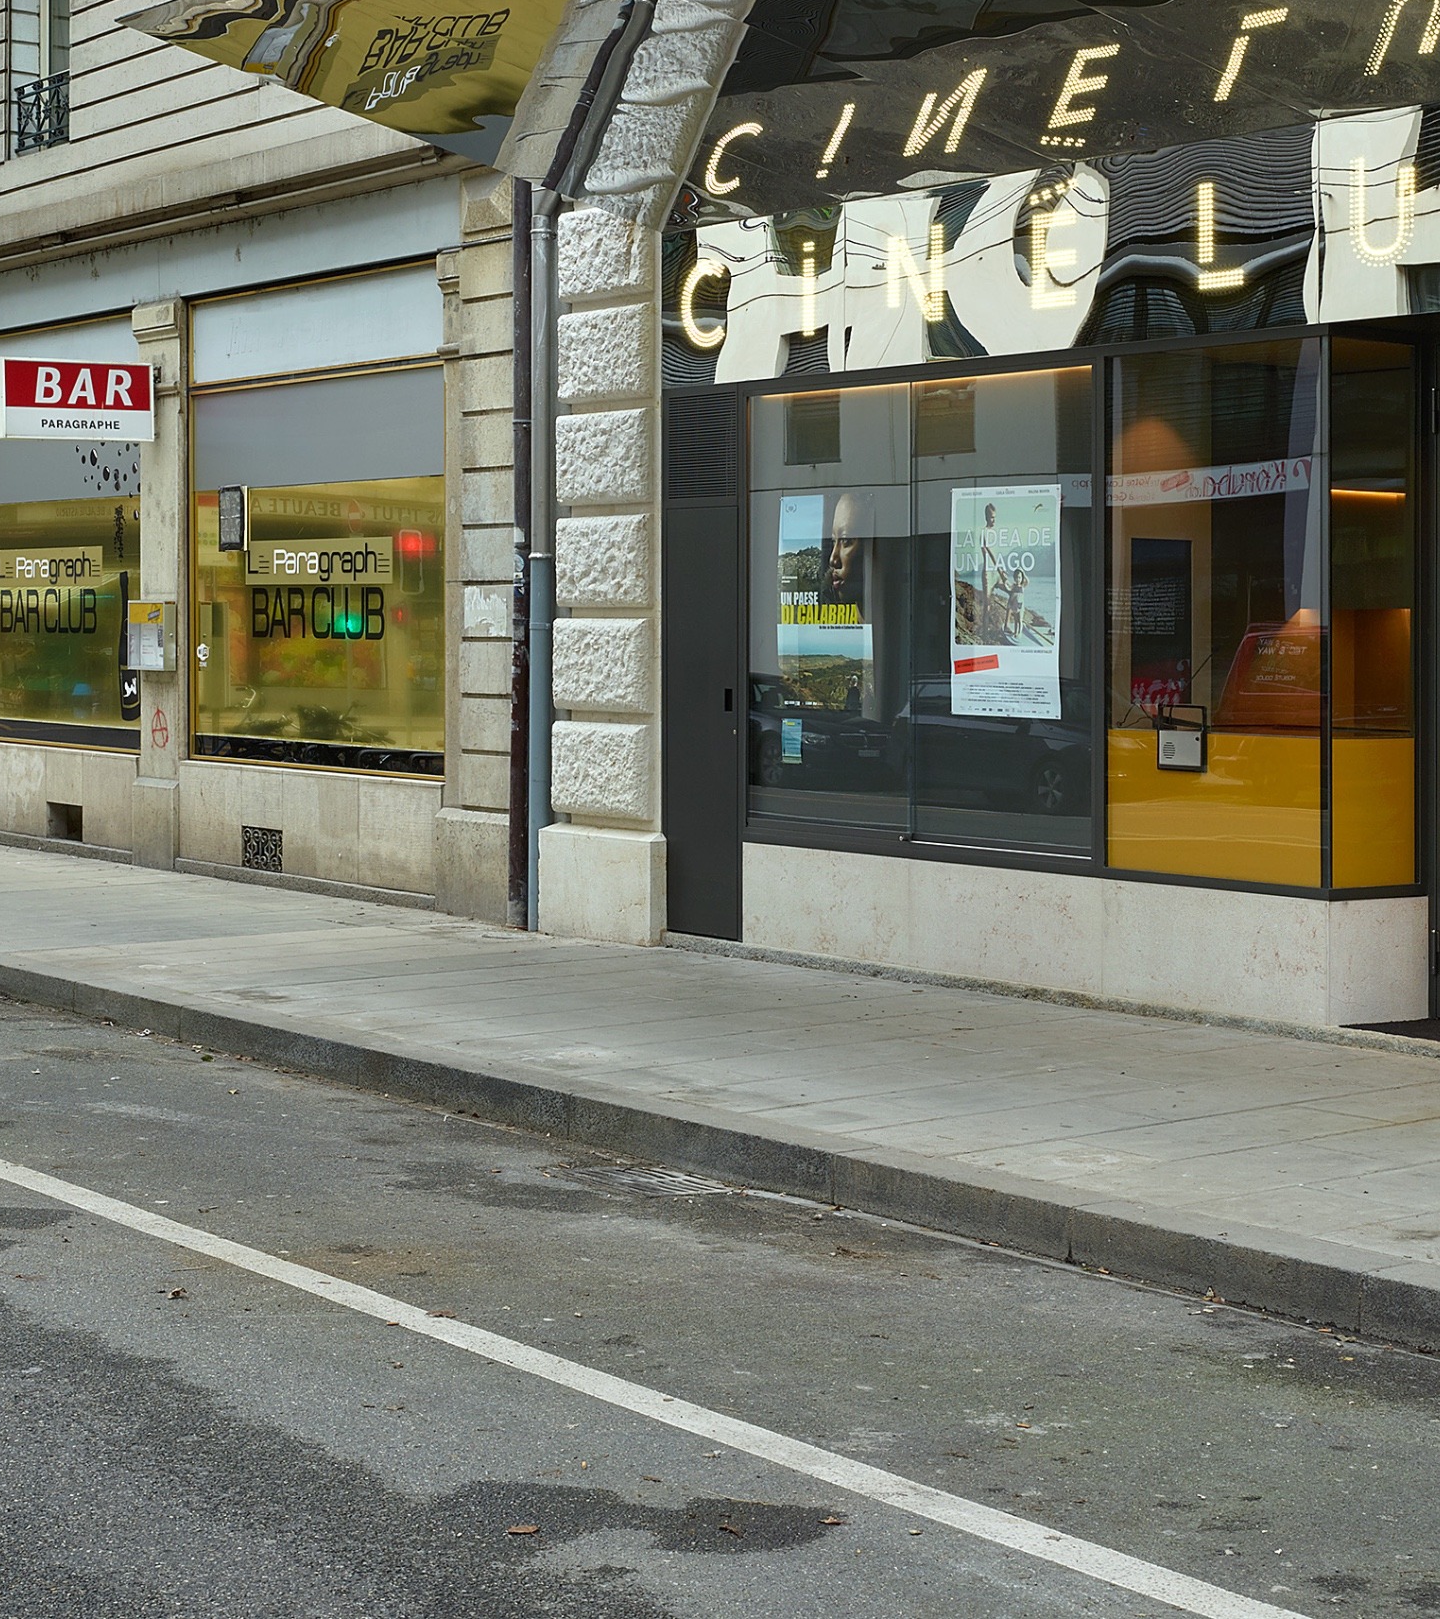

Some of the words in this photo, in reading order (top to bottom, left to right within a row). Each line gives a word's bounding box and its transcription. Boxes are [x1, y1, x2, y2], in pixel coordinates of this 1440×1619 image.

[35, 366, 133, 406] BAR
[41, 419, 121, 430] PARAGRAPHE
[955, 530, 975, 548] LA
[981, 528, 1022, 548] IDEA
[1028, 527, 1051, 547] DE
[955, 553, 979, 572] UN
[985, 551, 1035, 572] LAGO
[781, 591, 792, 605] UN
[793, 591, 819, 606] PAESE
[0, 589, 40, 633] BAR
[44, 588, 97, 634] CLUB
[252, 587, 306, 639] BAR
[312, 586, 386, 641] CLUB
[781, 604, 795, 625] DI
[797, 603, 859, 625] CALABRIA
